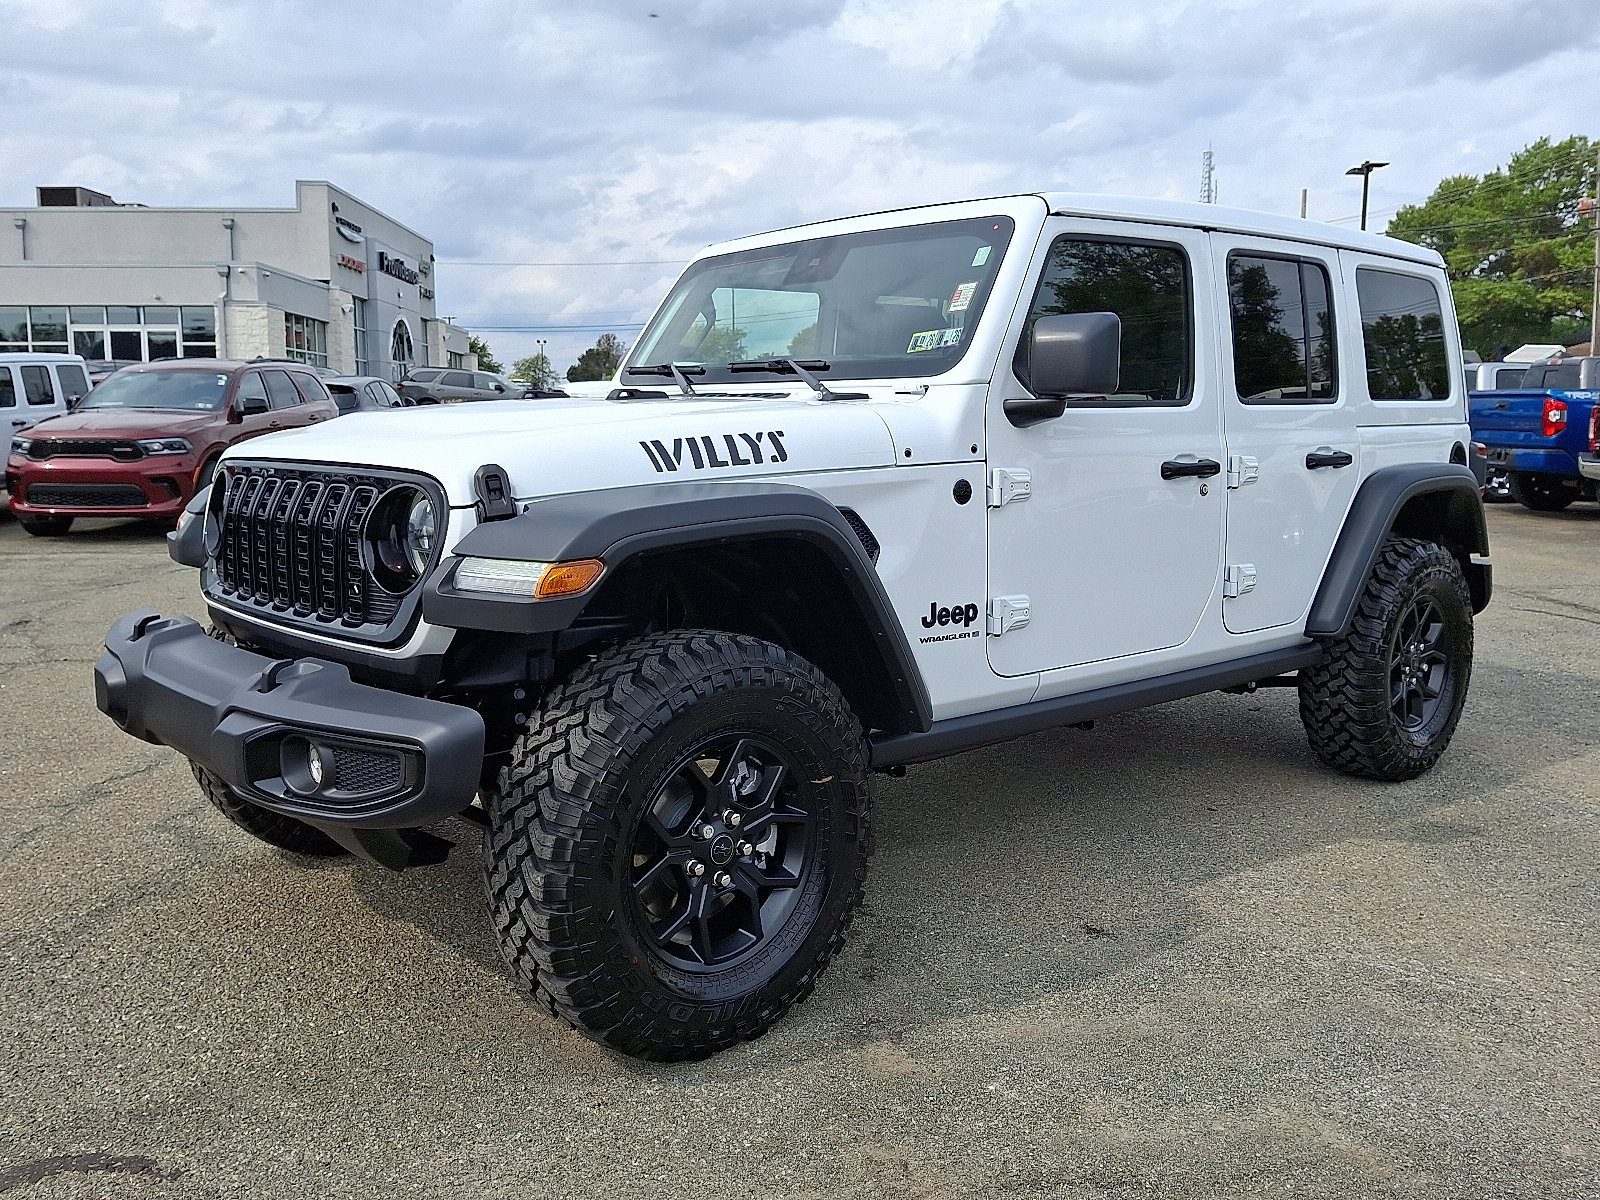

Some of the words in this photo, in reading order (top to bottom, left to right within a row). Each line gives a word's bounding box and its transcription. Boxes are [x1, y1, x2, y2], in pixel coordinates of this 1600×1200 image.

[639, 431, 788, 473] WILLYS
[921, 602, 979, 629] Jeep
[919, 632, 971, 645] WRANGLER
